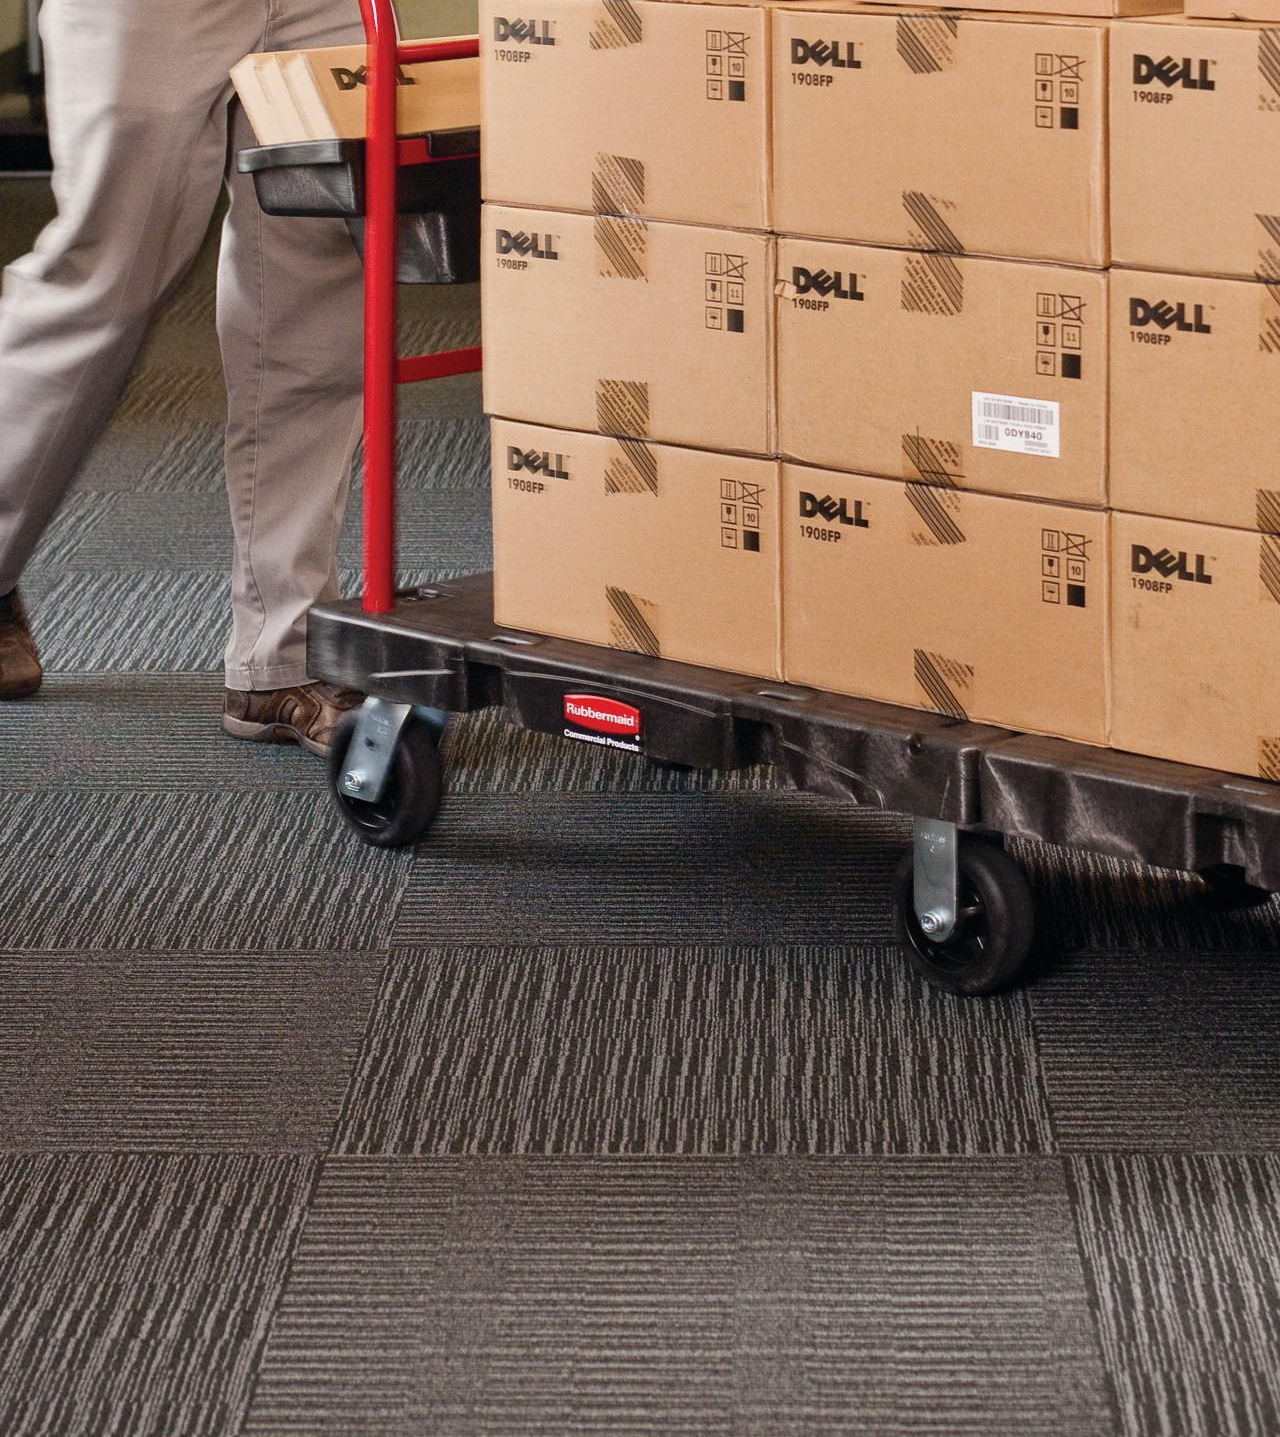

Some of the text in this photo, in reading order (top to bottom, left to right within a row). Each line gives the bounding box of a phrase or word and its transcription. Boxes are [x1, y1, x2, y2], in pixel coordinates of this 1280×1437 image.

[494, 16, 556, 47] DELL
[494, 49, 531, 63] 1908FP
[790, 37, 862, 70] DELL
[330, 64, 416, 90] DL
[791, 72, 834, 88] 1908FP
[1132, 53, 1215, 91] DELL
[1132, 90, 1174, 105] 1908FP
[495, 228, 559, 261] DELL
[496, 257, 529, 271] 1908FP
[791, 266, 864, 303] DELL
[791, 297, 830, 312] 1908FP
[1129, 297, 1211, 336] DELL
[1130, 330, 1172, 346] 1908FP
[507, 445, 569, 480] DELL
[507, 477, 545, 494] 1908FP
[799, 490, 869, 530] DELL
[799, 524, 842, 544] 1908FP
[1131, 543, 1212, 586] DELL
[1131, 577, 1173, 594] 1908FP
[566, 702, 635, 727] Rubbermaid
[563, 728, 640, 752] Commercial Products
